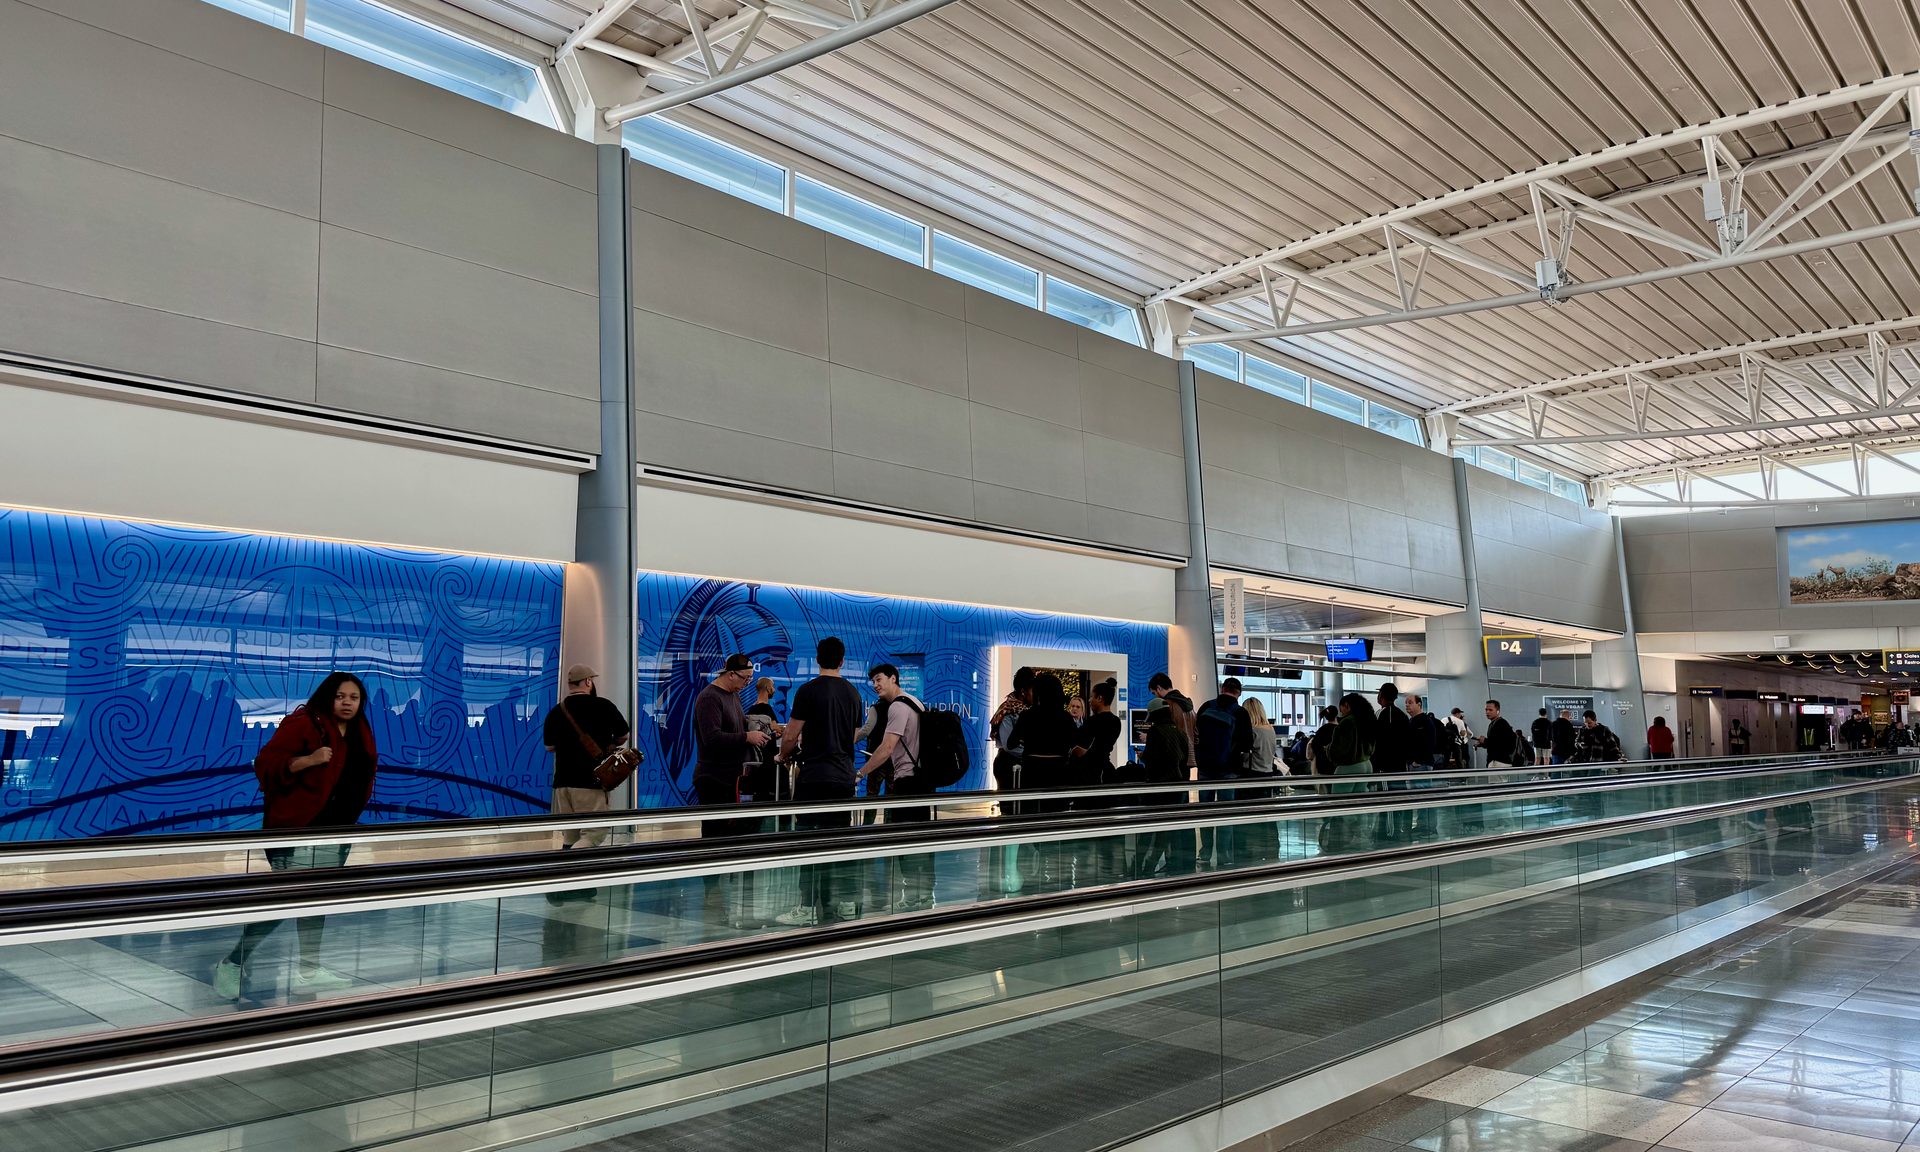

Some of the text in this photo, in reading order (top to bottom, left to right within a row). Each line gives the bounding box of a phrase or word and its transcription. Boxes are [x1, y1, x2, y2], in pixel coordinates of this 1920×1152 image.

[189, 628, 399, 653] WORLD SERVICE
[1500, 640, 1522, 655] D4
